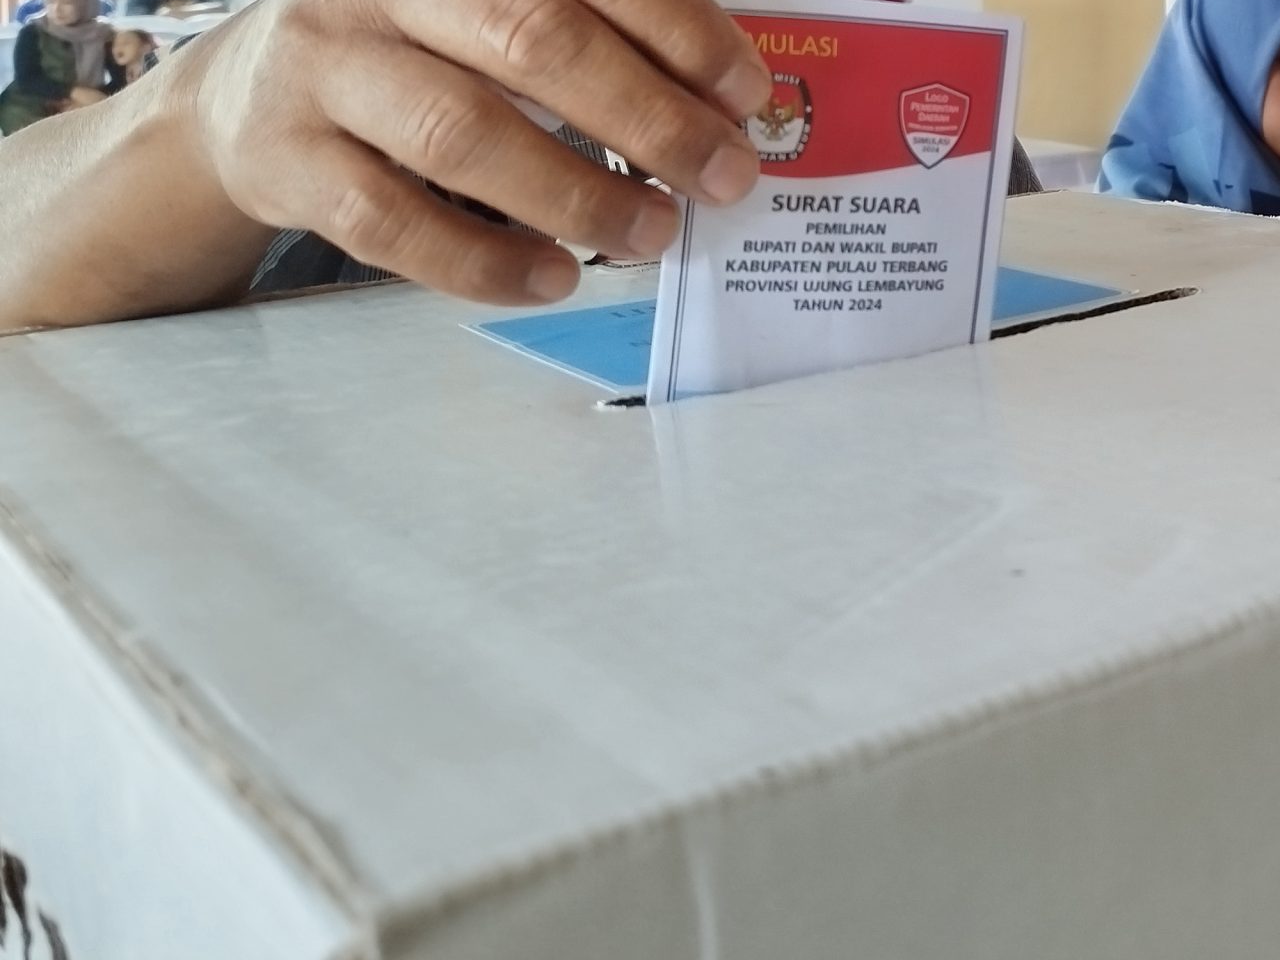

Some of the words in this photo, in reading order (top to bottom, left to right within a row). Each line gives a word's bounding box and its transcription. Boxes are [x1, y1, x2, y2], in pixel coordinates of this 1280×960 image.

[748, 32, 838, 57] MULASI
[772, 194, 843, 213] SURAT
[850, 196, 921, 214] SUARA
[805, 222, 887, 235] PEMILIHAN
[743, 240, 796, 253] BUPATI
[801, 241, 835, 253] DAN
[840, 241, 886, 254] WAKIL
[891, 242, 938, 254] BUPATI
[725, 259, 822, 273] KABUPATEN
[826, 260, 877, 273] PULAU
[881, 260, 948, 273] TERBANG
[725, 280, 798, 292] PROVINSI
[803, 280, 852, 292] UJUNG
[858, 279, 944, 292] LEMBAYUNG
[793, 299, 844, 311] TAHUN
[848, 298, 882, 311] 2024
